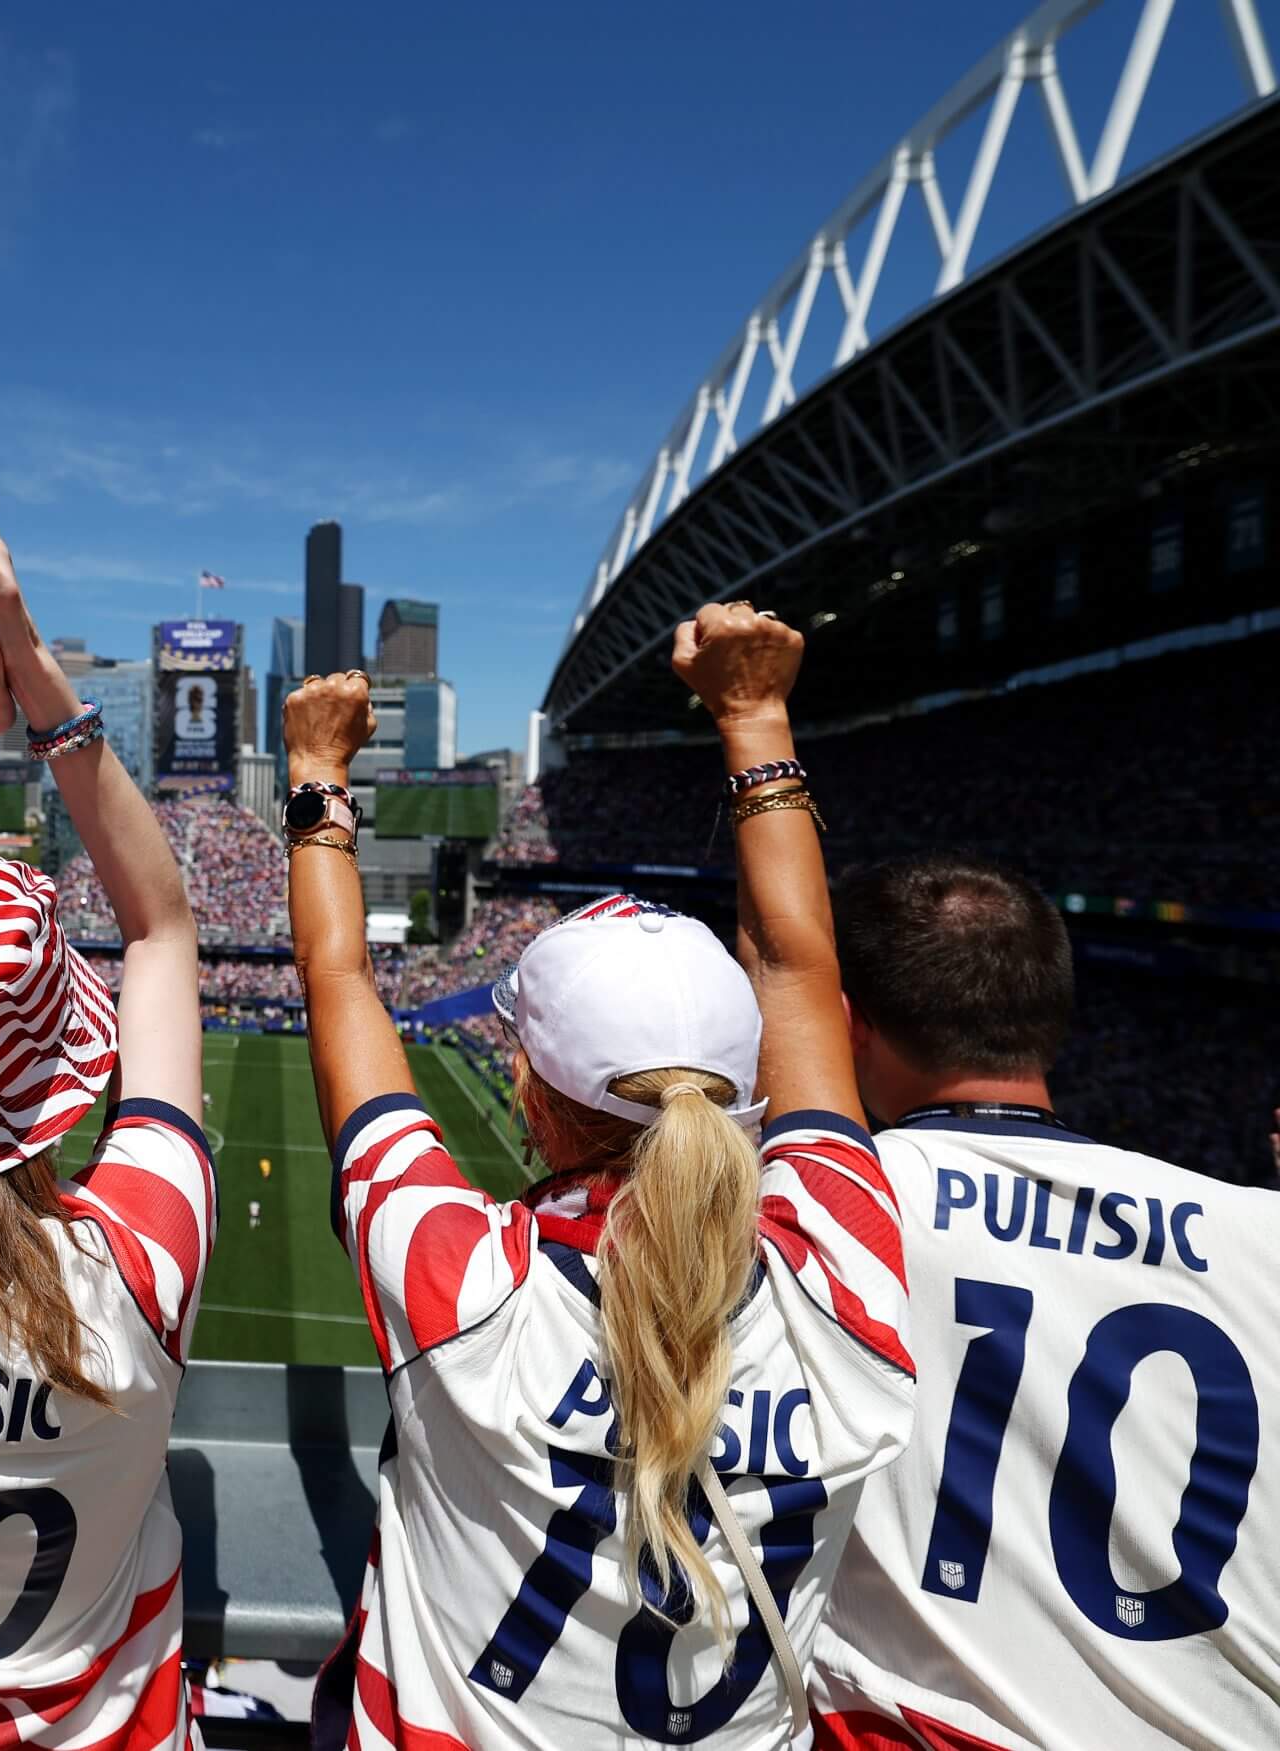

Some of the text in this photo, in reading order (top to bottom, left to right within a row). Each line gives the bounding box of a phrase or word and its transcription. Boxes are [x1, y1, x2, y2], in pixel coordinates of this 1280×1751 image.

[933, 1168, 1208, 1272] PULISIC
[920, 1277, 1260, 1641] 10
[941, 1563, 962, 1575] USA
[1118, 1598, 1142, 1611] USA
[492, 1662, 514, 1679] USA
[669, 1712, 690, 1723] USA
